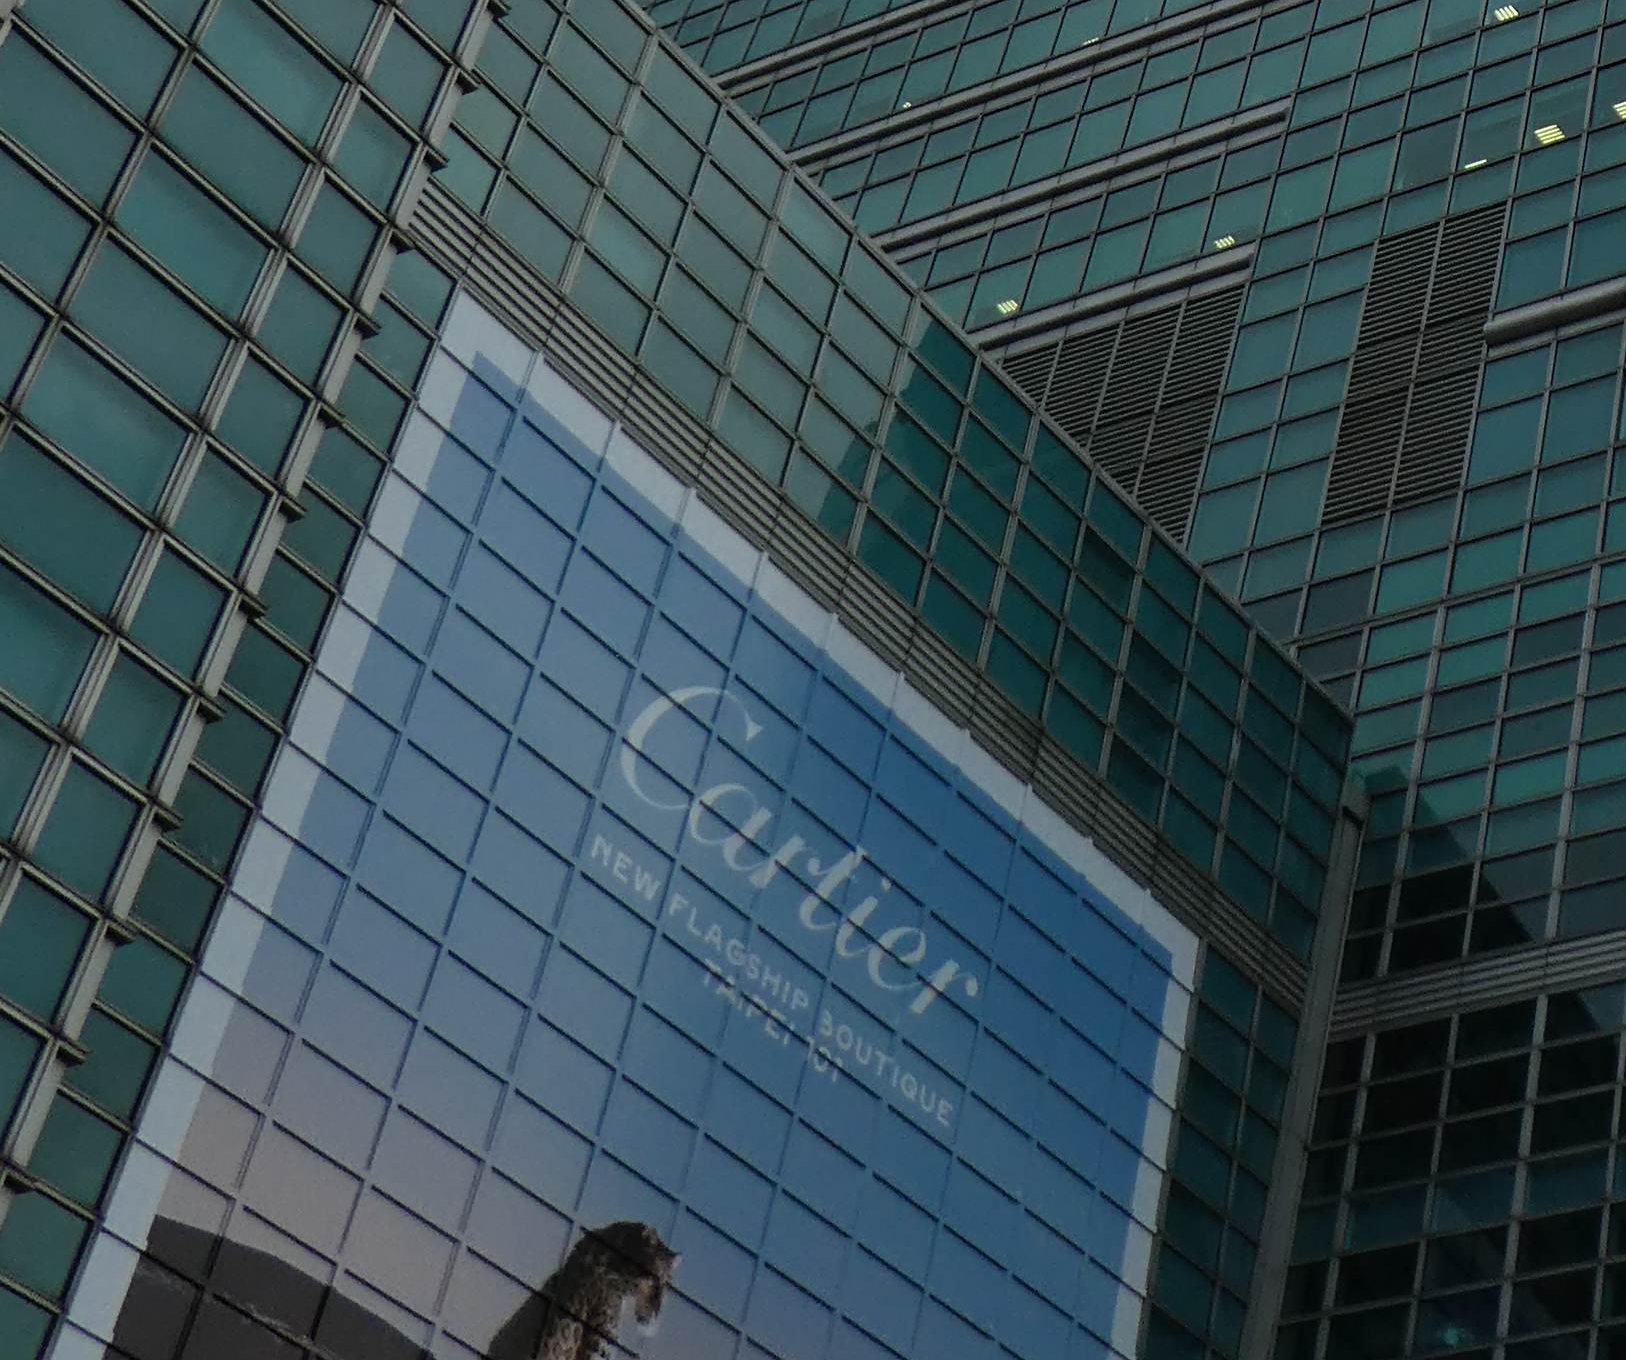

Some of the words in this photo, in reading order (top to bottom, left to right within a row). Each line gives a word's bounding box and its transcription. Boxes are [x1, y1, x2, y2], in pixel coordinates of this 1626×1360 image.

[590, 833, 660, 901] NEW
[668, 891, 811, 1011] FLAGSHIP
[819, 1009, 954, 1127] BOUTIQUE
[620, 686, 979, 1015] Cartier
[702, 958, 795, 1046] TAIPEI
[805, 1035, 845, 1083] 101
